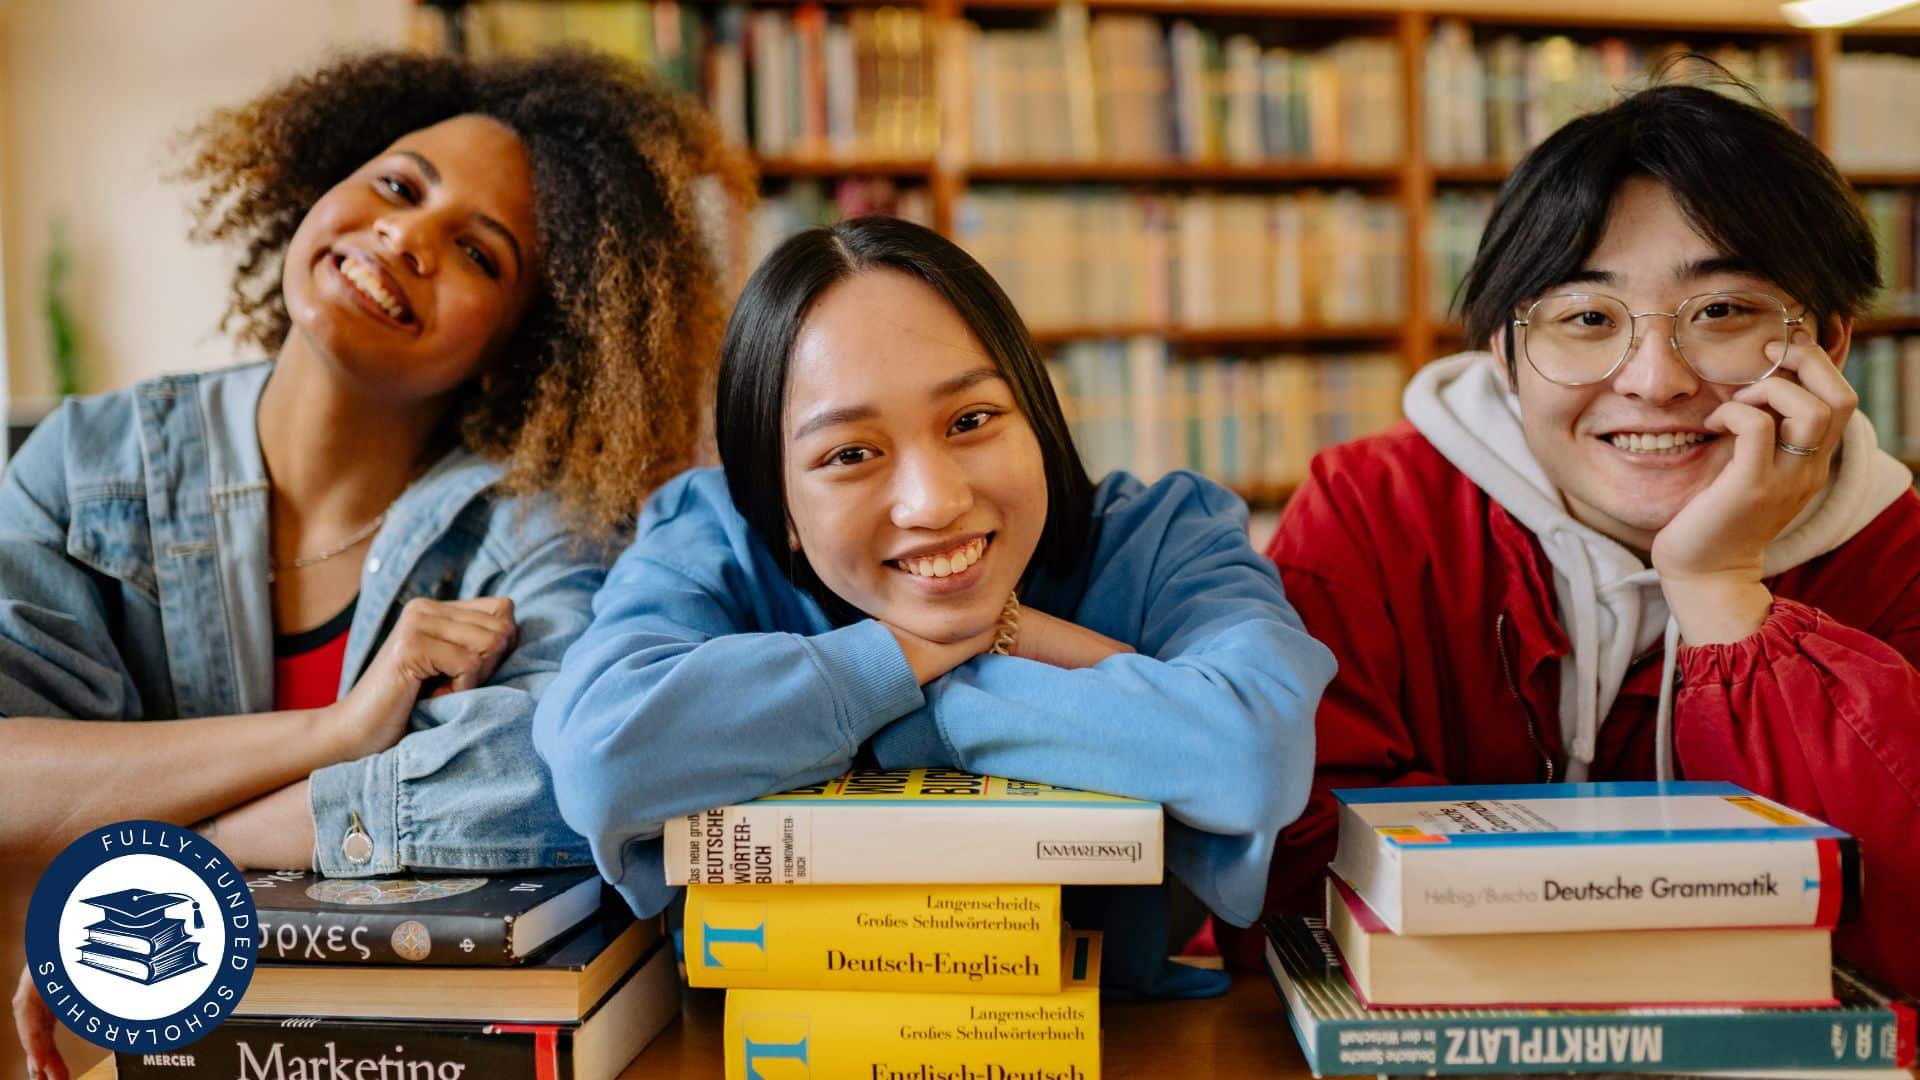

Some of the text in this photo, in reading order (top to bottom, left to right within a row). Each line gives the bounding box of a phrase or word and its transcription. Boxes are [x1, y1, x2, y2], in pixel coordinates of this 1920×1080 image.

[690, 841, 700, 865] neue
[729, 816, 751, 885] WÖRTER-
[755, 846, 772, 885] BUCH
[1545, 876, 1643, 901] Deutsche
[1651, 872, 1780, 899] Grammatik
[927, 895, 1040, 912] Langenscheidts
[857, 912, 1040, 931] Großes Schulwörterbuch
[827, 949, 1040, 982] Deutsch-Englisch
[970, 1006, 1085, 1022] Langenscheidts
[900, 1025, 1085, 1041] Großes Schulwörterbuch
[1444, 1025, 1663, 1065] MARKTPLATZ
[143, 1054, 196, 1067] MERCER
[236, 1041, 466, 1080] Marketing
